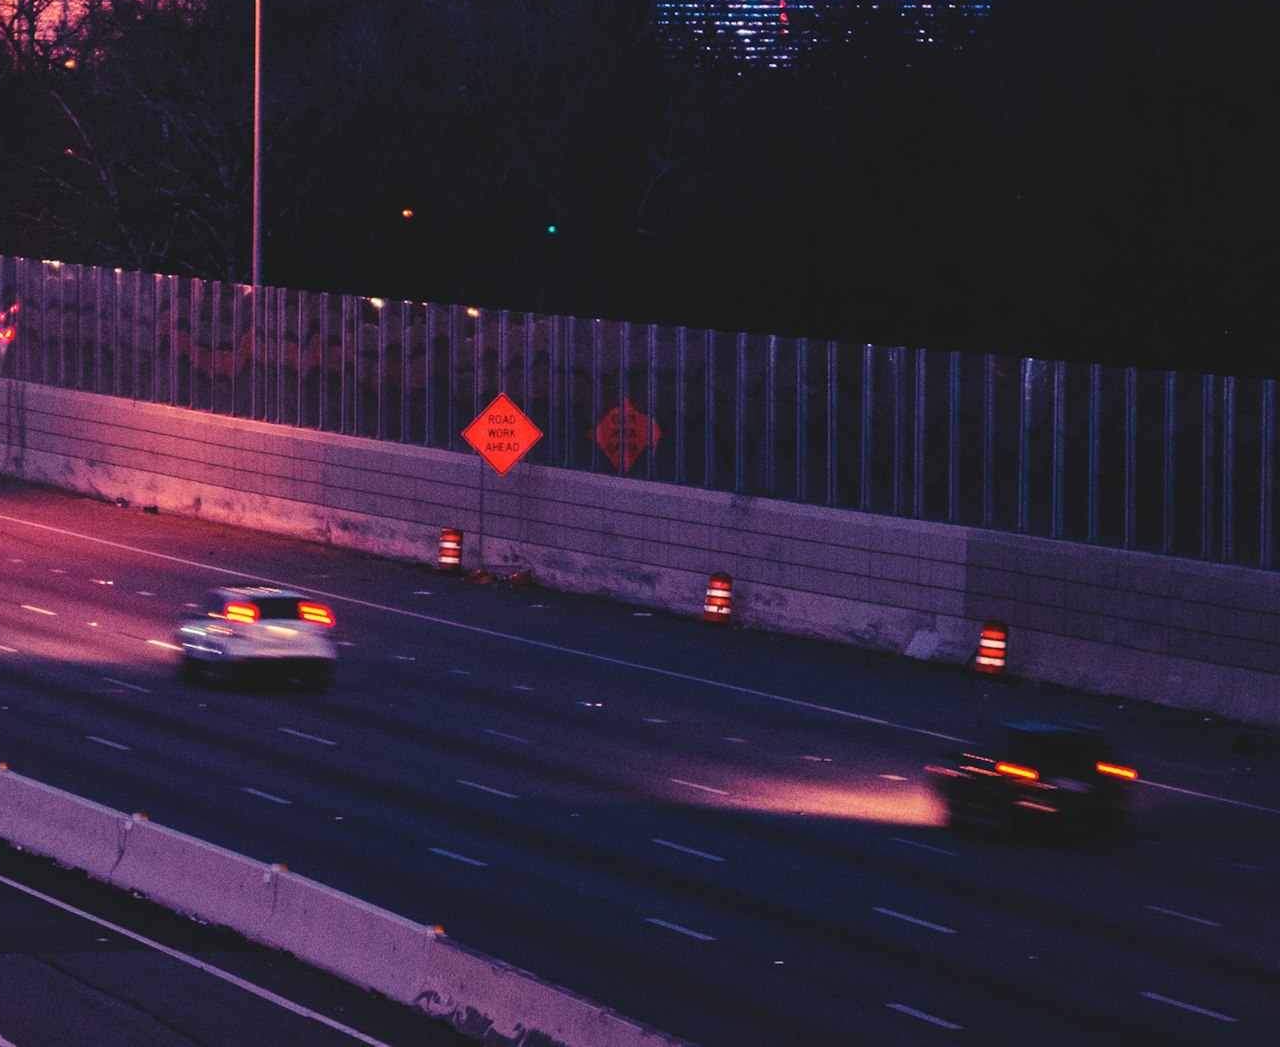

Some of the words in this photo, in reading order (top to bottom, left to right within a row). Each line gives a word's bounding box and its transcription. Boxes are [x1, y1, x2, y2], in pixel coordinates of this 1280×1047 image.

[488, 414, 516, 425] ROAD
[488, 428, 516, 439] WORK
[485, 442, 520, 452] AHEAD
